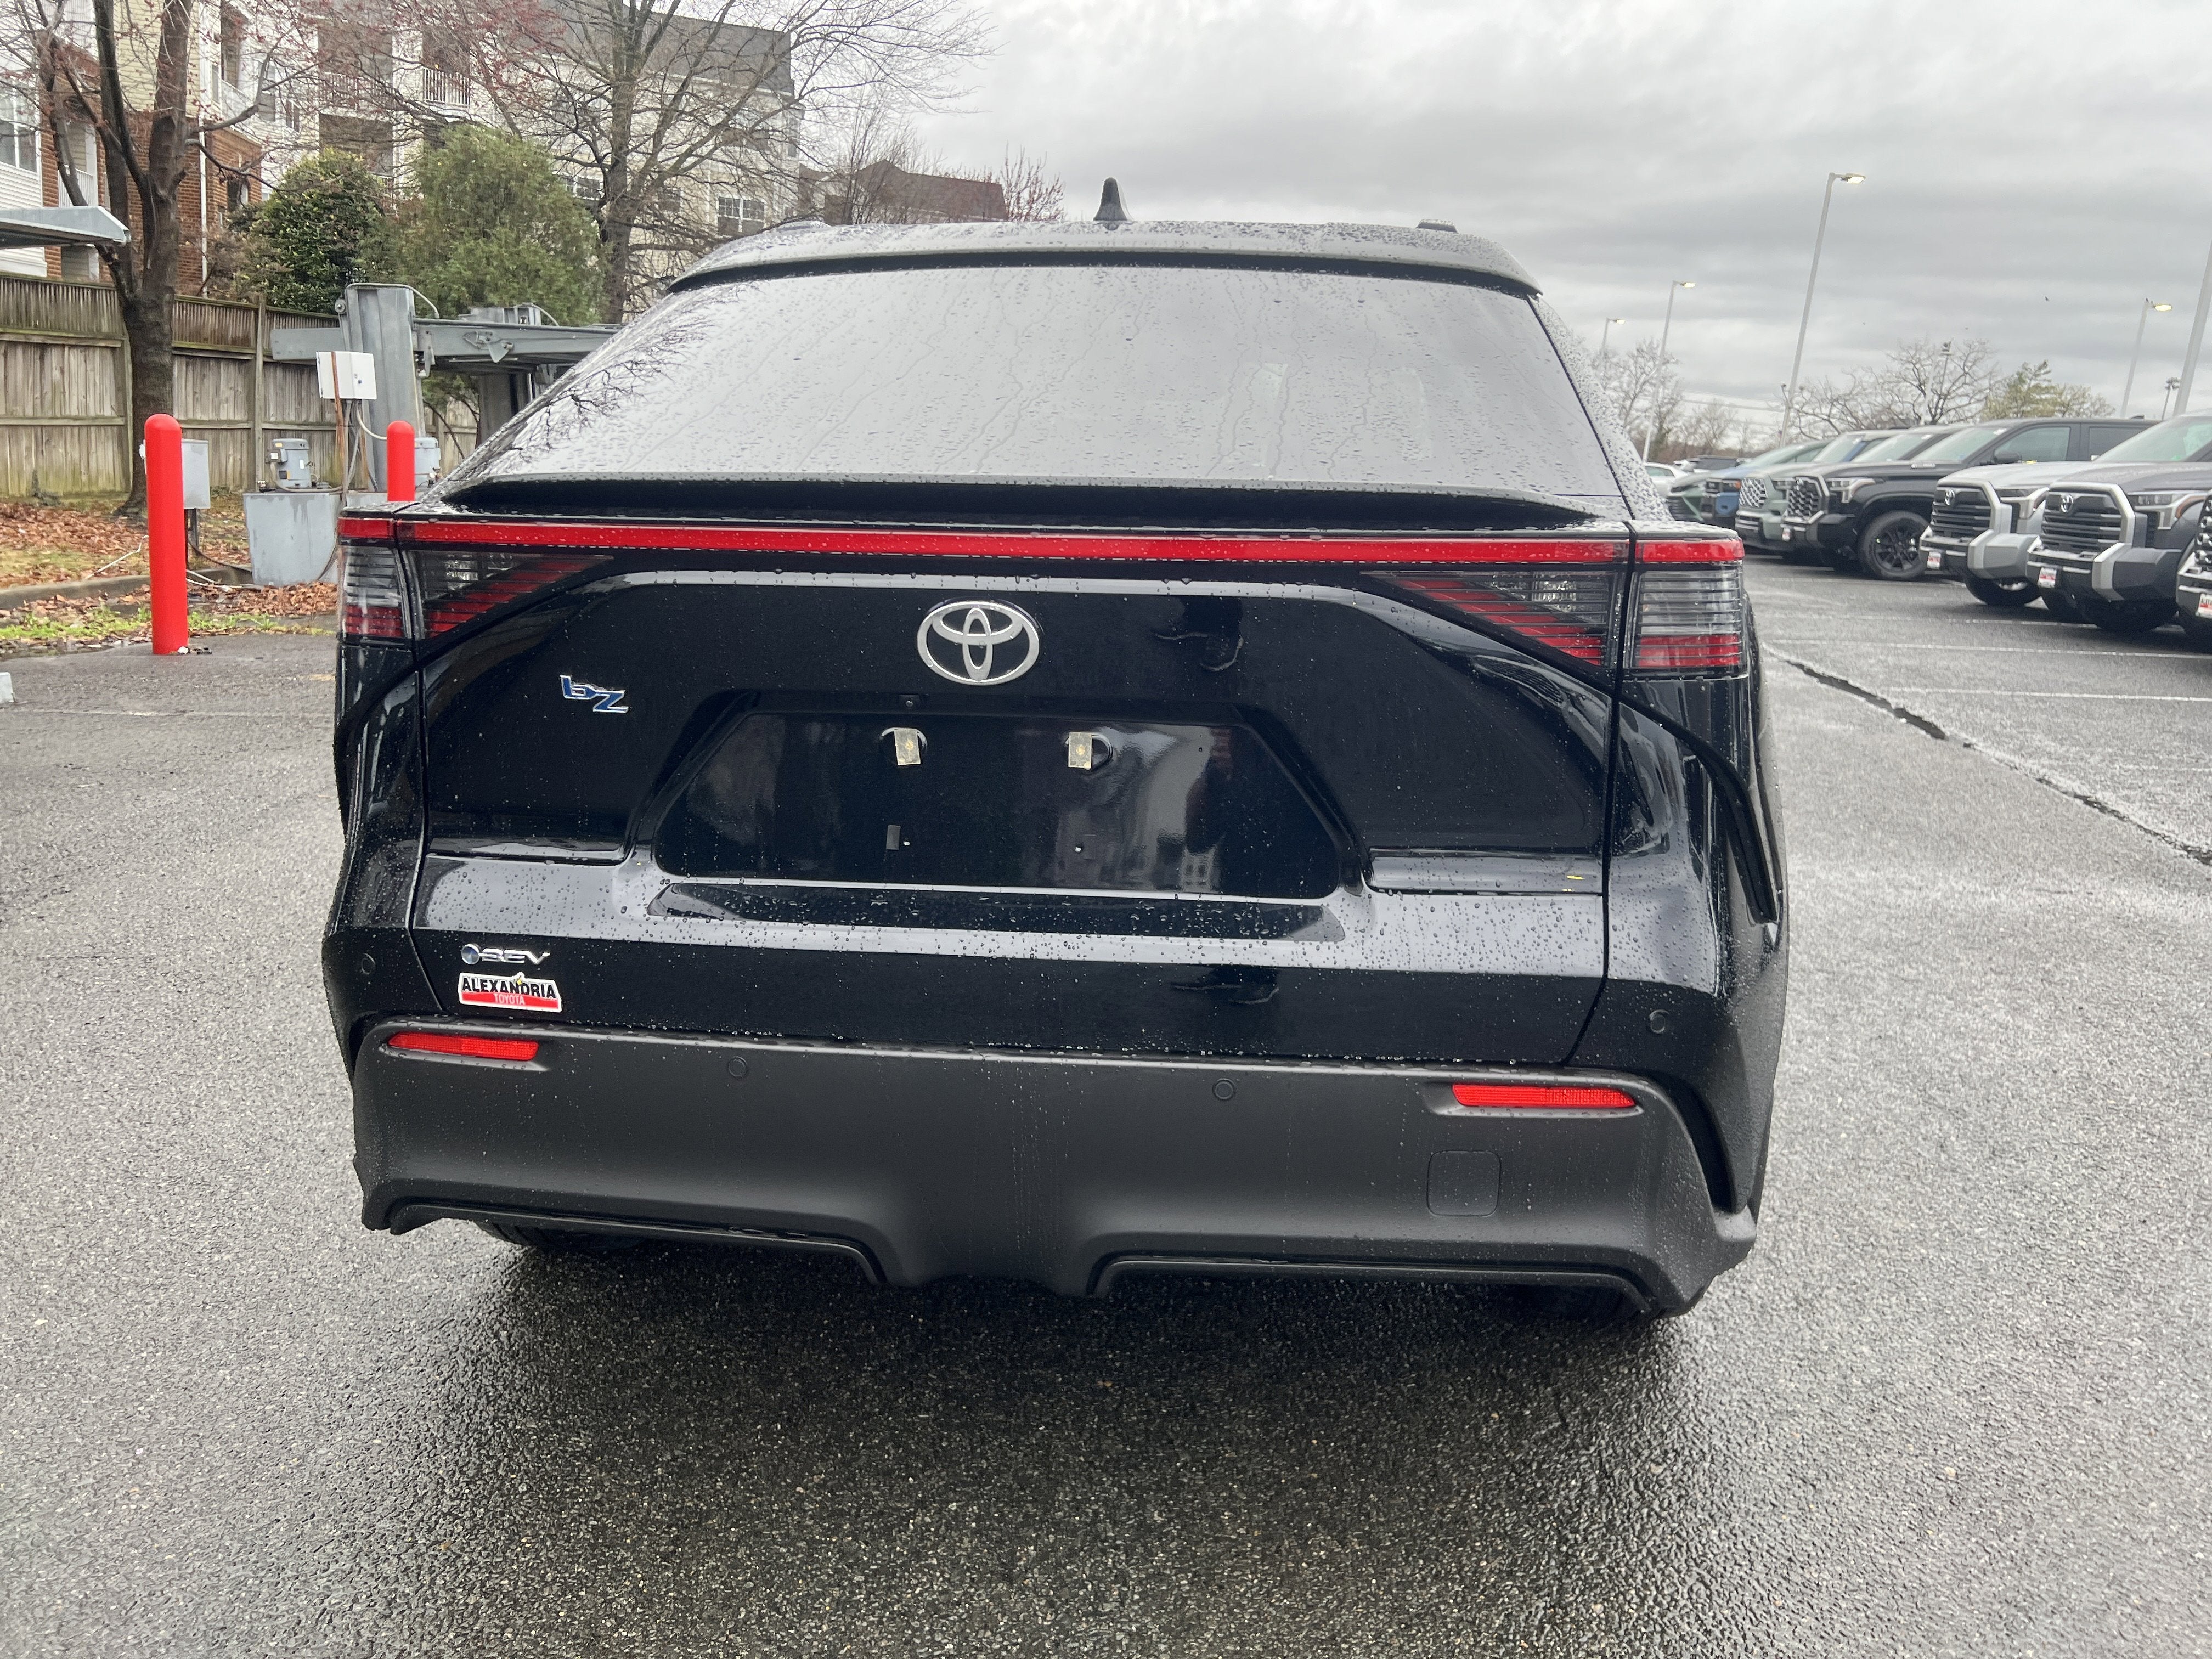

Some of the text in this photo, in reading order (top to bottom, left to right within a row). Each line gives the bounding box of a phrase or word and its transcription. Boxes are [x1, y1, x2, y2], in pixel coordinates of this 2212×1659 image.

[481, 947, 550, 965] BEV
[462, 977, 556, 999] ALEXANDRIA
[494, 992, 526, 1005] TOYOTA
